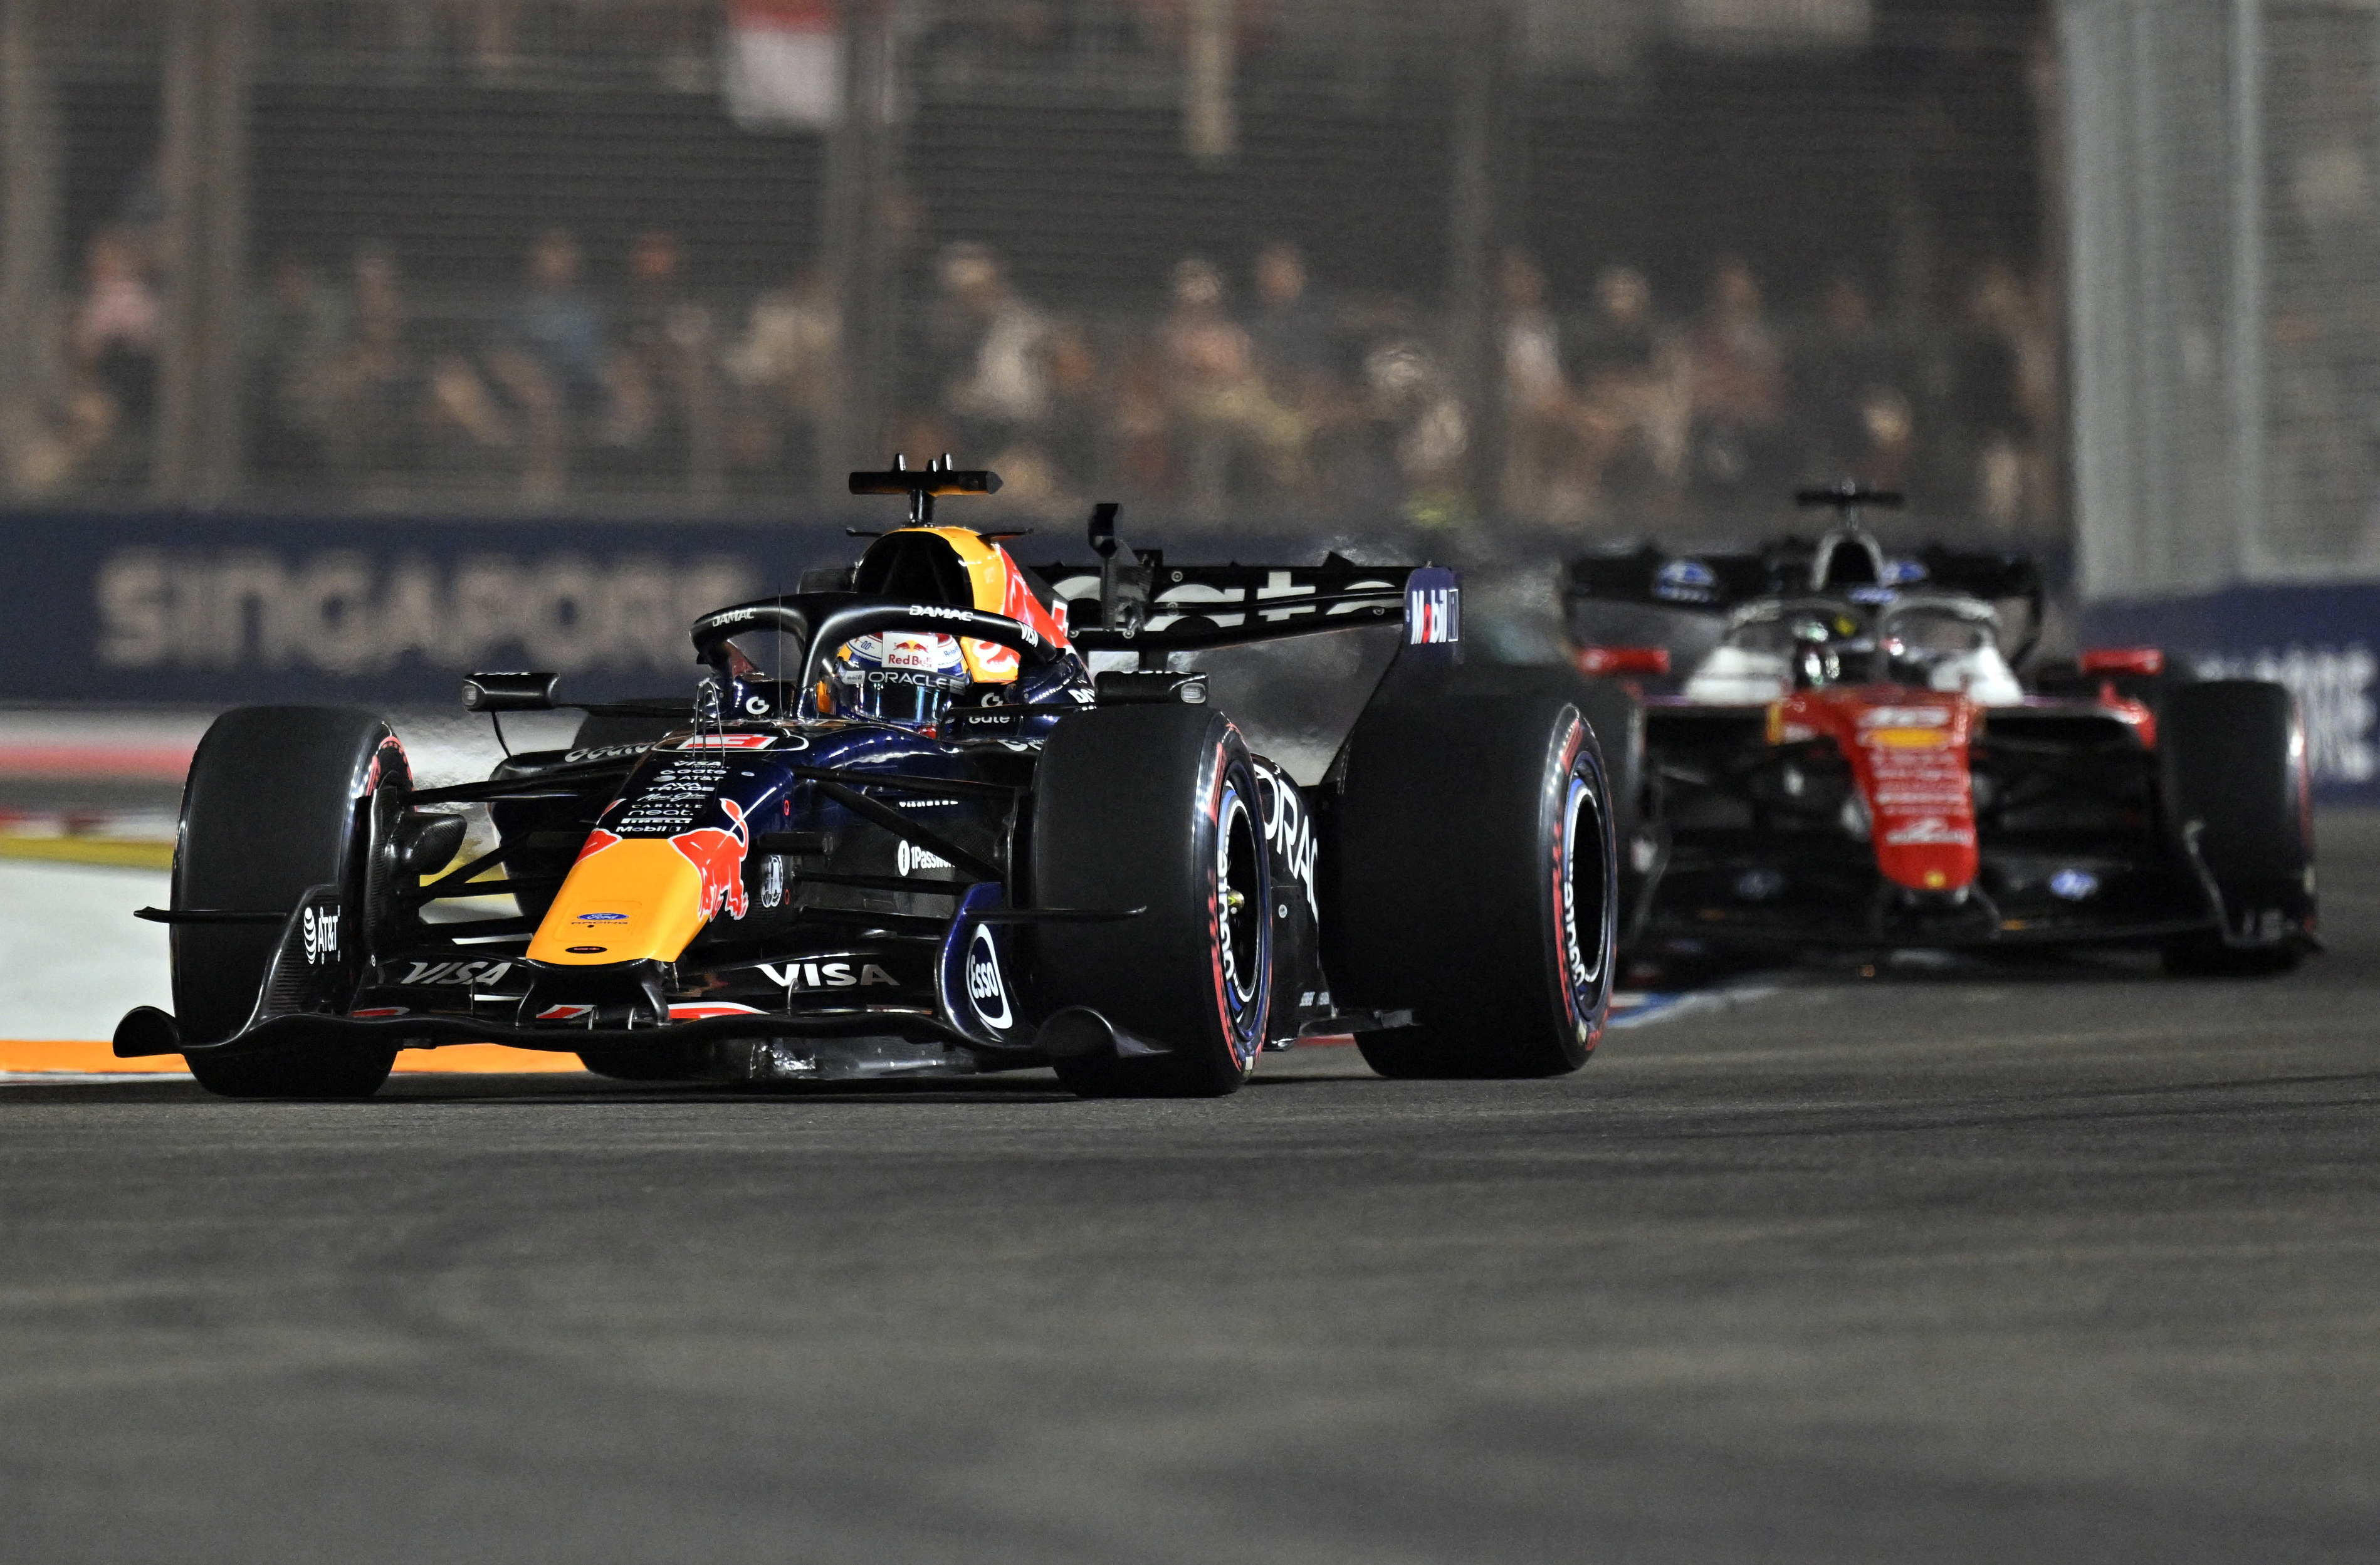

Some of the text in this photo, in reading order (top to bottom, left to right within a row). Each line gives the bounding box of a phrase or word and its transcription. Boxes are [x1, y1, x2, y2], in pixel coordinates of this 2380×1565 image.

[97, 544, 757, 674] SINGAPORE
[910, 605, 973, 621] DAMAC
[1410, 587, 1447, 645] Mobil
[1016, 622, 1038, 647] VISA
[888, 654, 910, 665] Red
[868, 671, 947, 689] ORACLE
[910, 846, 956, 869] 1Passw
[318, 916, 338, 952] AT&T
[400, 961, 512, 986] VISA
[757, 963, 900, 987] VISA
